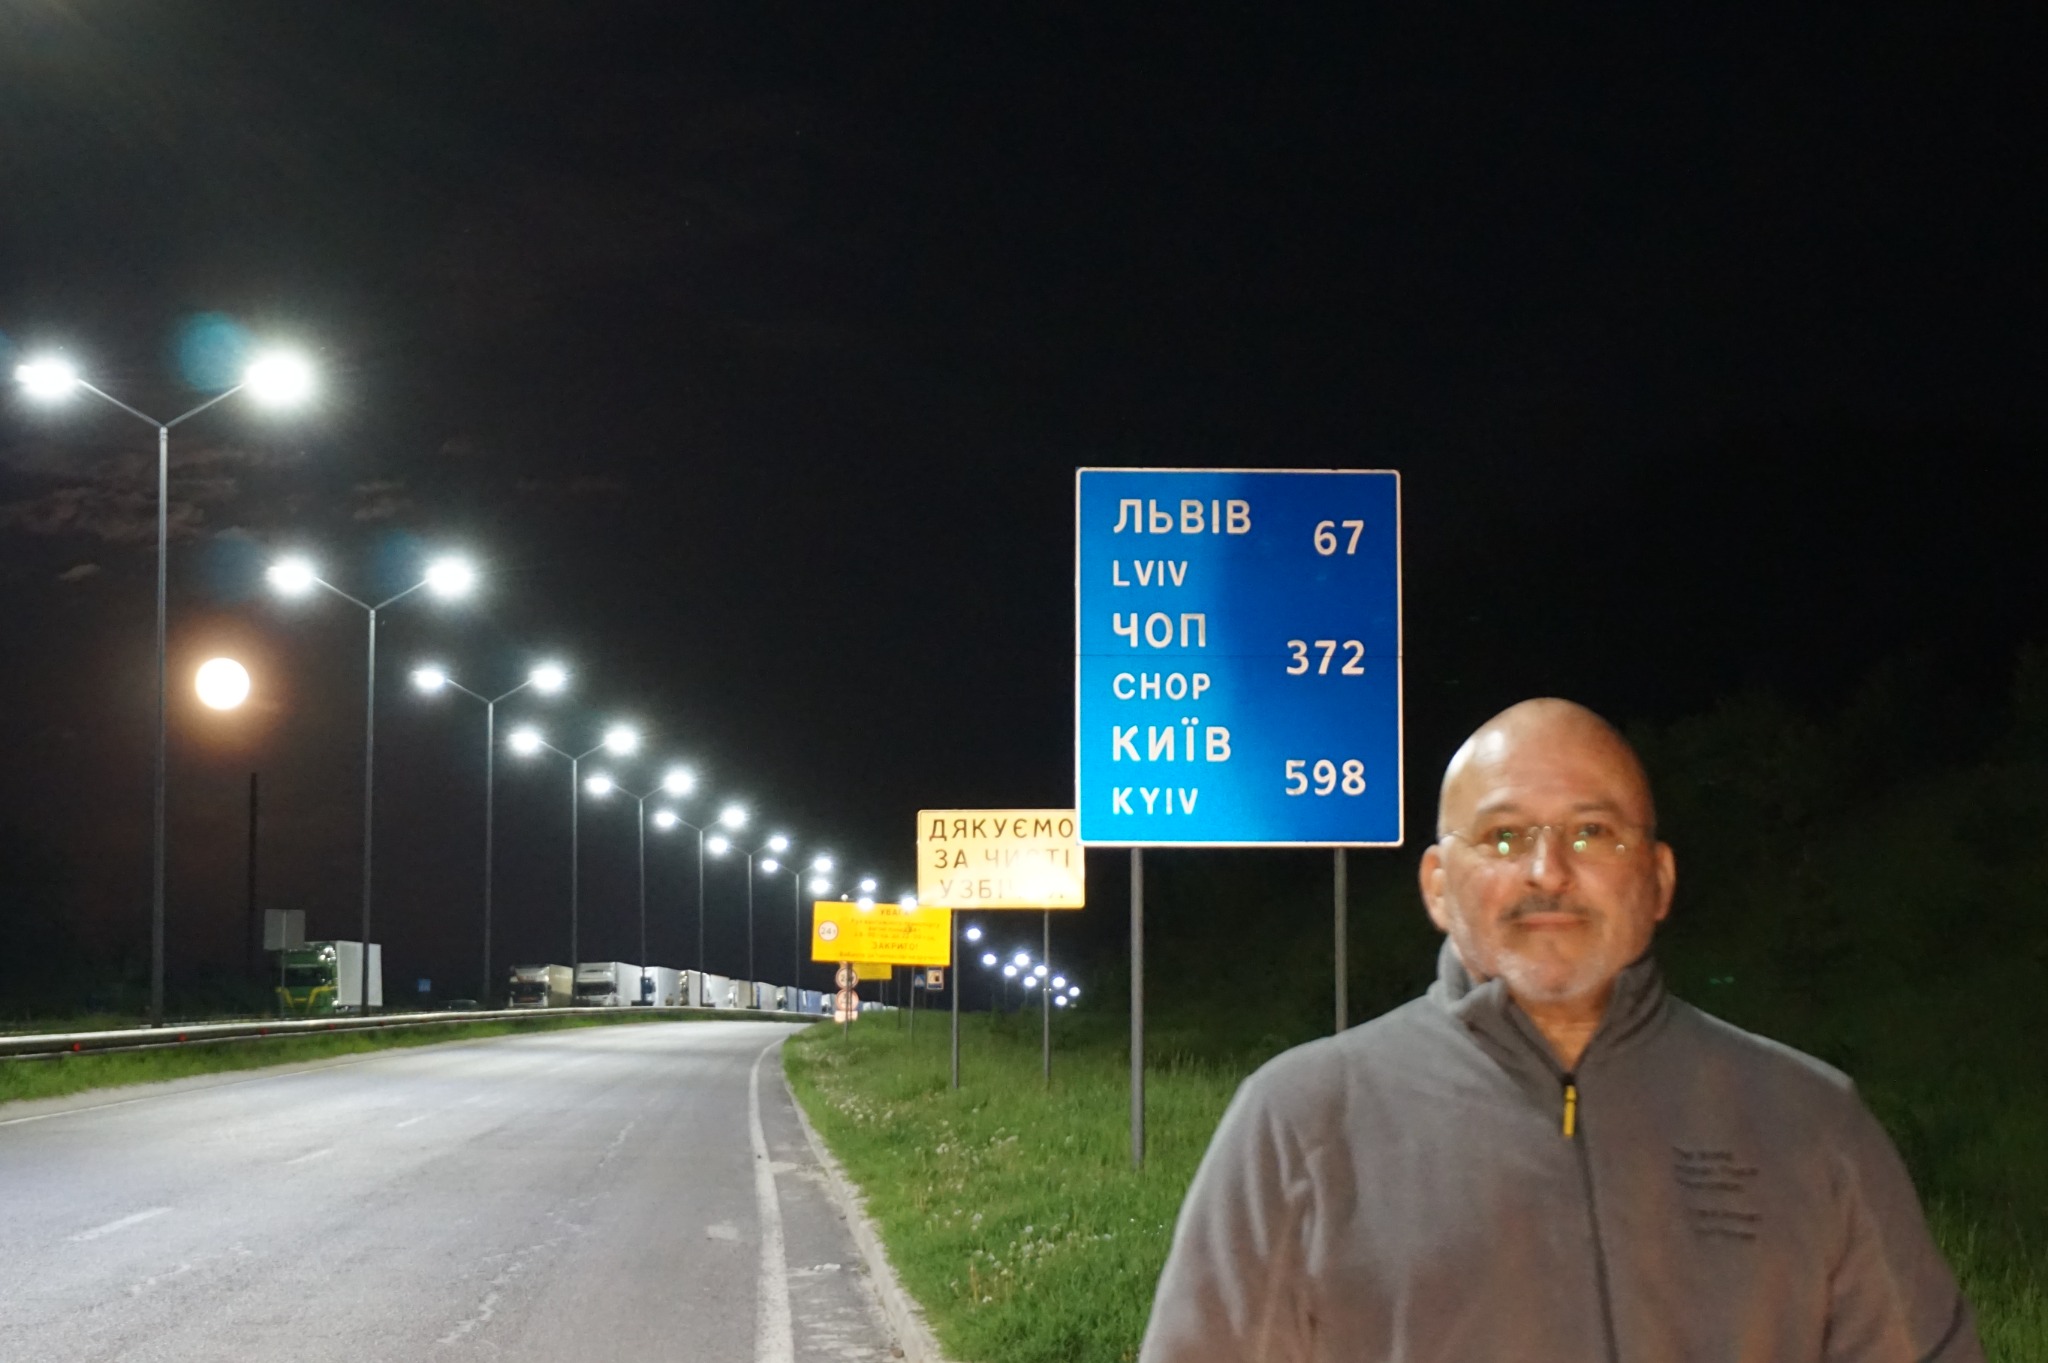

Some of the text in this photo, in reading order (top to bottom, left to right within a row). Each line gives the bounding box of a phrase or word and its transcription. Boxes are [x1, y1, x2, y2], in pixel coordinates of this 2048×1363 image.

[1113, 498, 1252, 535] ЛЬВІВ
[1313, 519, 1365, 556] 67
[1112, 559, 1188, 587] LVIV
[1112, 612, 1207, 648] ЧОП
[1285, 639, 1365, 675] 372
[1112, 672, 1211, 700] CHOP
[1112, 716, 1232, 762] КИЇВ
[1285, 758, 1366, 796] 598
[1112, 787, 1199, 815] KYIV
[928, 817, 1074, 842] ДЯКУЄМО
[934, 848, 1069, 869] ЗА ЧИТІ
